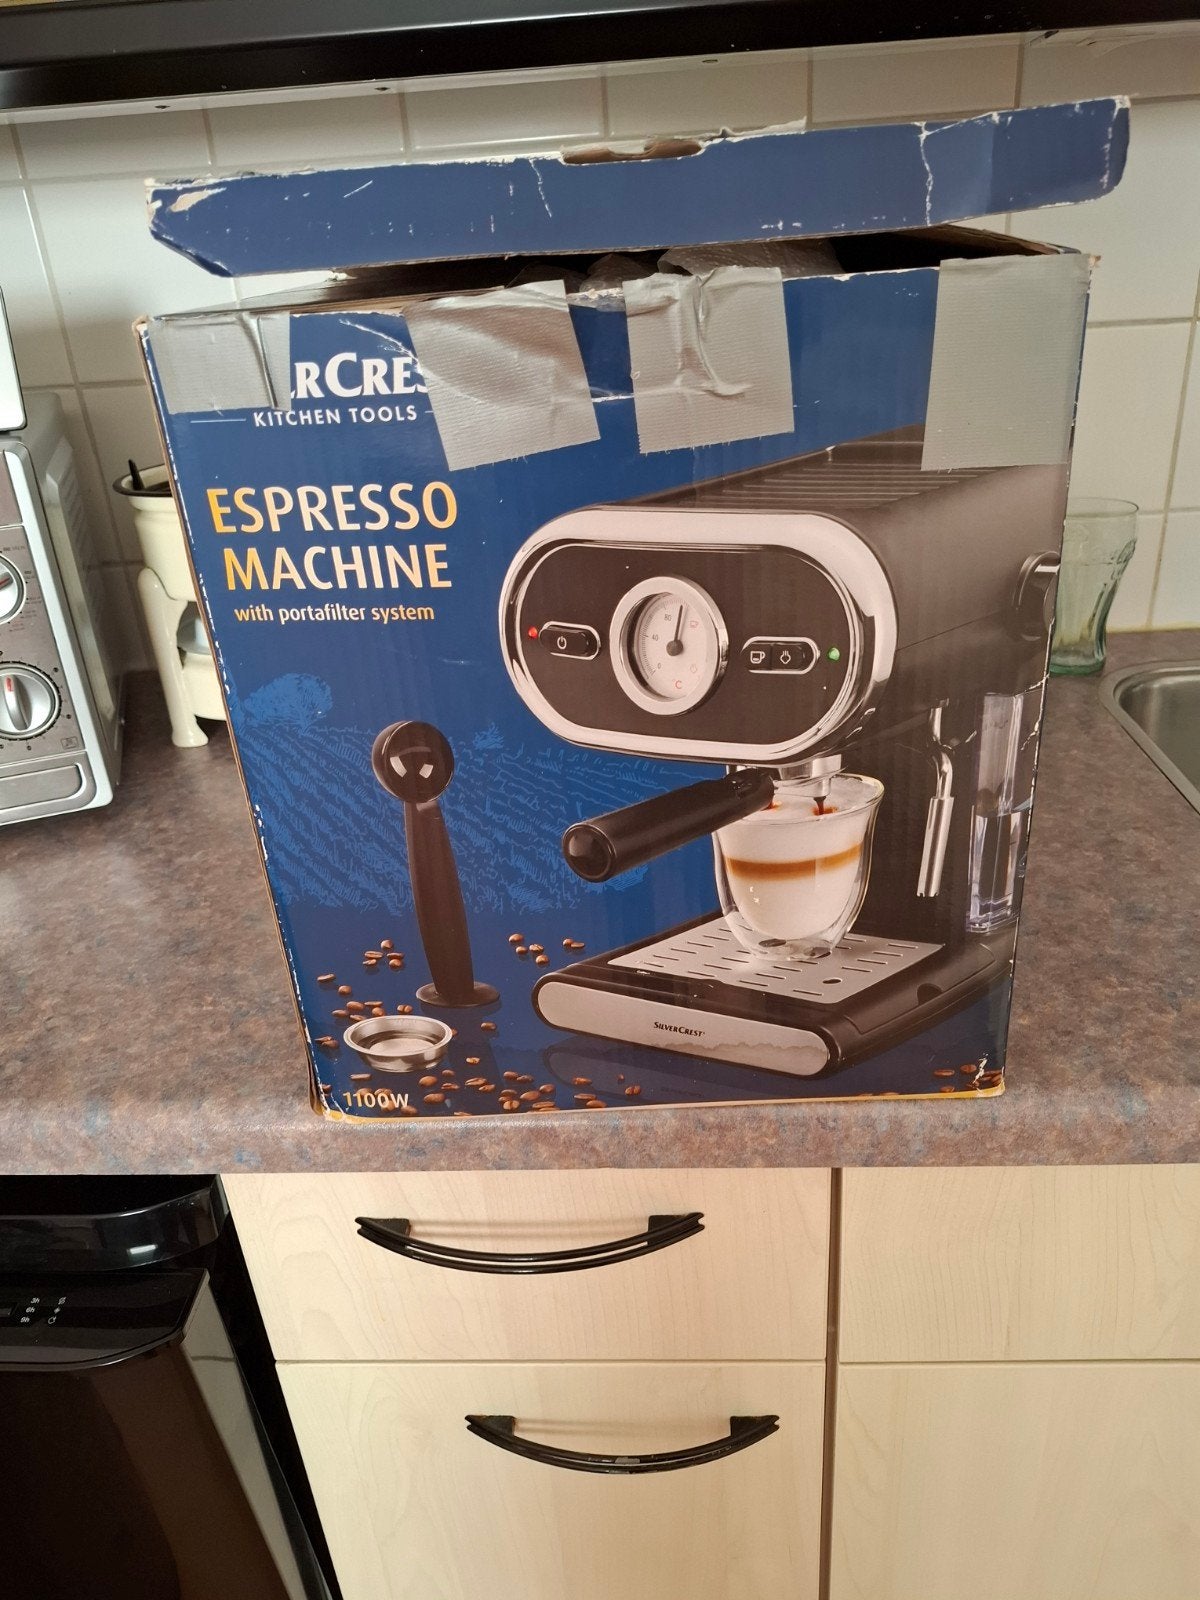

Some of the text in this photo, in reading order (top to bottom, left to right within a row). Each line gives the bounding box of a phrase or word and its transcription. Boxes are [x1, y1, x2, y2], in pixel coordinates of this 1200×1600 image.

[290, 351, 428, 399] RCRE
[253, 405, 417, 427] KITCHEN TOOLS
[206, 481, 458, 534] ESPRESSO
[222, 543, 452, 591] MACHINE
[234, 602, 435, 625] with portafilter system
[663, 613, 672, 622] 80
[342, 1092, 409, 1108] 1100W
